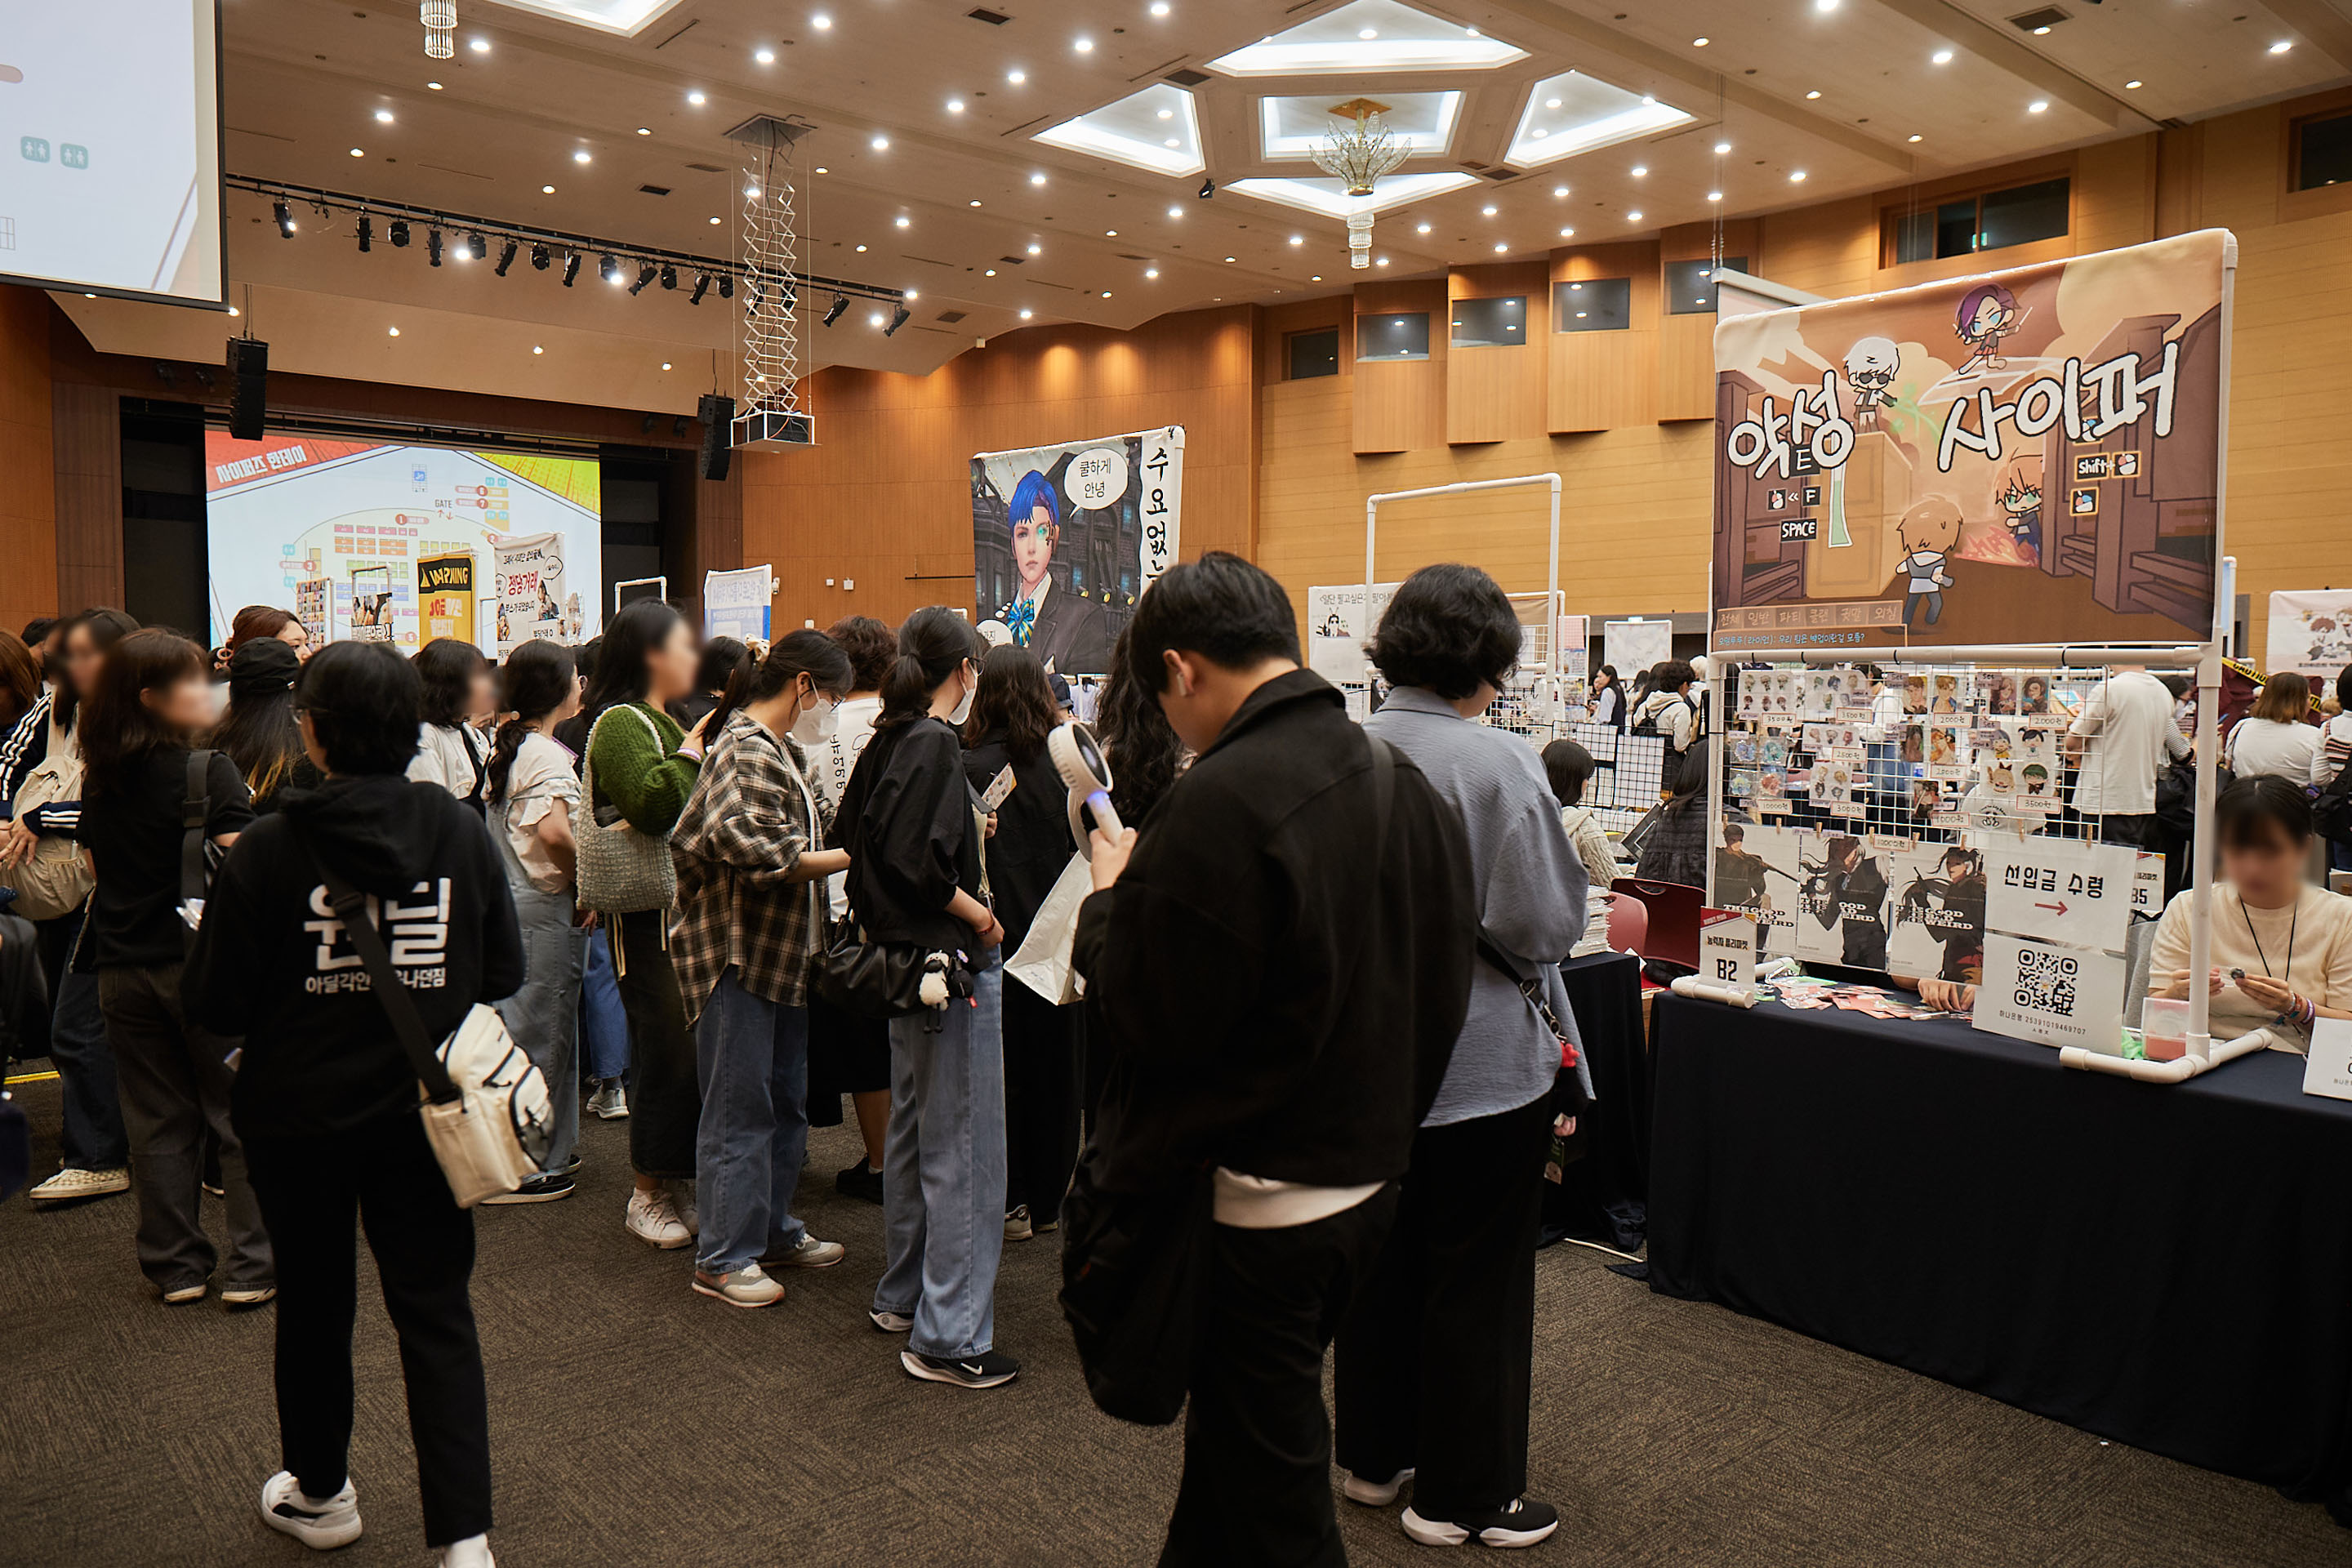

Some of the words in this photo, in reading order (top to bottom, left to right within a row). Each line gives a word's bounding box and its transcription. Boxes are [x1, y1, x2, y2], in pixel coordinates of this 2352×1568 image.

[1937, 341, 2179, 472] 사이퍼
[1079, 457, 1112, 478] 쿨하게
[1796, 448, 1812, 470] E
[216, 455, 269, 483] 사이퍼즈
[1084, 482, 1106, 500] 안녕
[1806, 489, 1816, 503] F
[434, 499, 452, 509] GATE
[1781, 521, 1815, 538] SPACE
[429, 567, 469, 586] WARNING
[508, 570, 539, 595] 정당거래
[1720, 613, 1740, 626] 전체
[1748, 611, 1770, 626] 일반
[1779, 611, 1801, 623] 파티
[1874, 606, 1897, 621] 외침
[1779, 635, 1792, 644] 우리
[2233, 663, 2269, 684] CAUTIO
[2004, 864, 2057, 892] 선입금
[2068, 873, 2104, 899] 수령
[1707, 935, 1724, 947] 능력자
[1716, 958, 1737, 982] B2
[305, 972, 372, 995] 아딜각인
[1999, 1009, 2023, 1022] 하나은행
